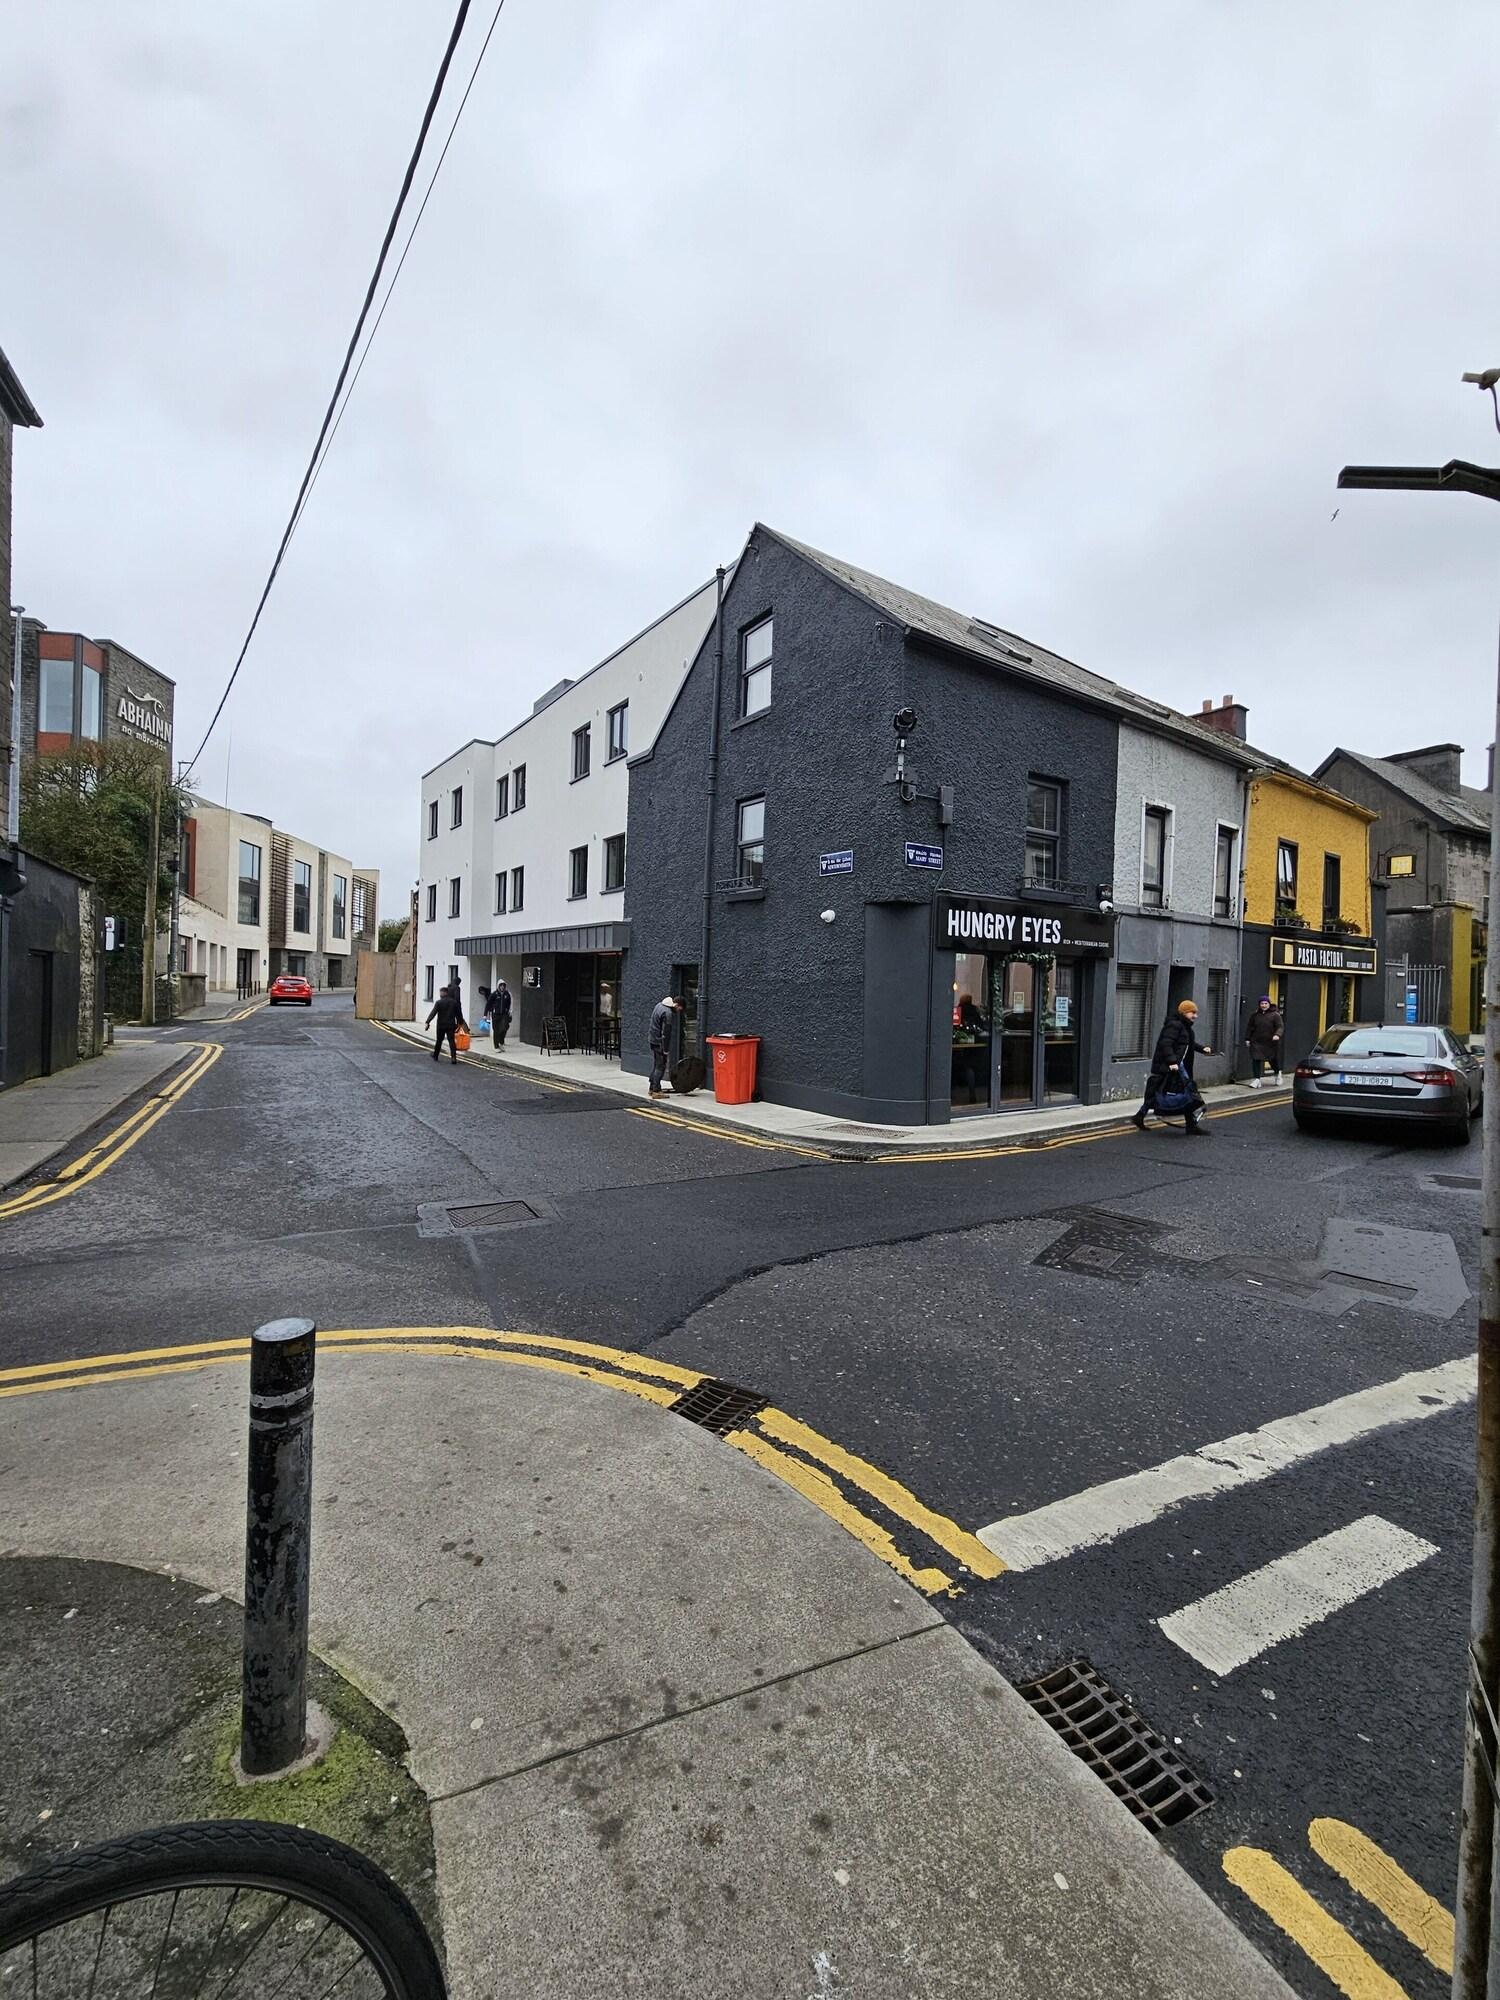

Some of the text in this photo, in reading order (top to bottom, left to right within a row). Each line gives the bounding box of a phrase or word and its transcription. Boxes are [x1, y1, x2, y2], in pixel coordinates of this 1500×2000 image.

[117, 697, 172, 744] ABHAINN
[122, 725, 132, 736] na
[948, 909, 1061, 944] HUNGRY EYES
[1297, 947, 1317, 966] PASTA
[1319, 949, 1343, 968] FACTORY
